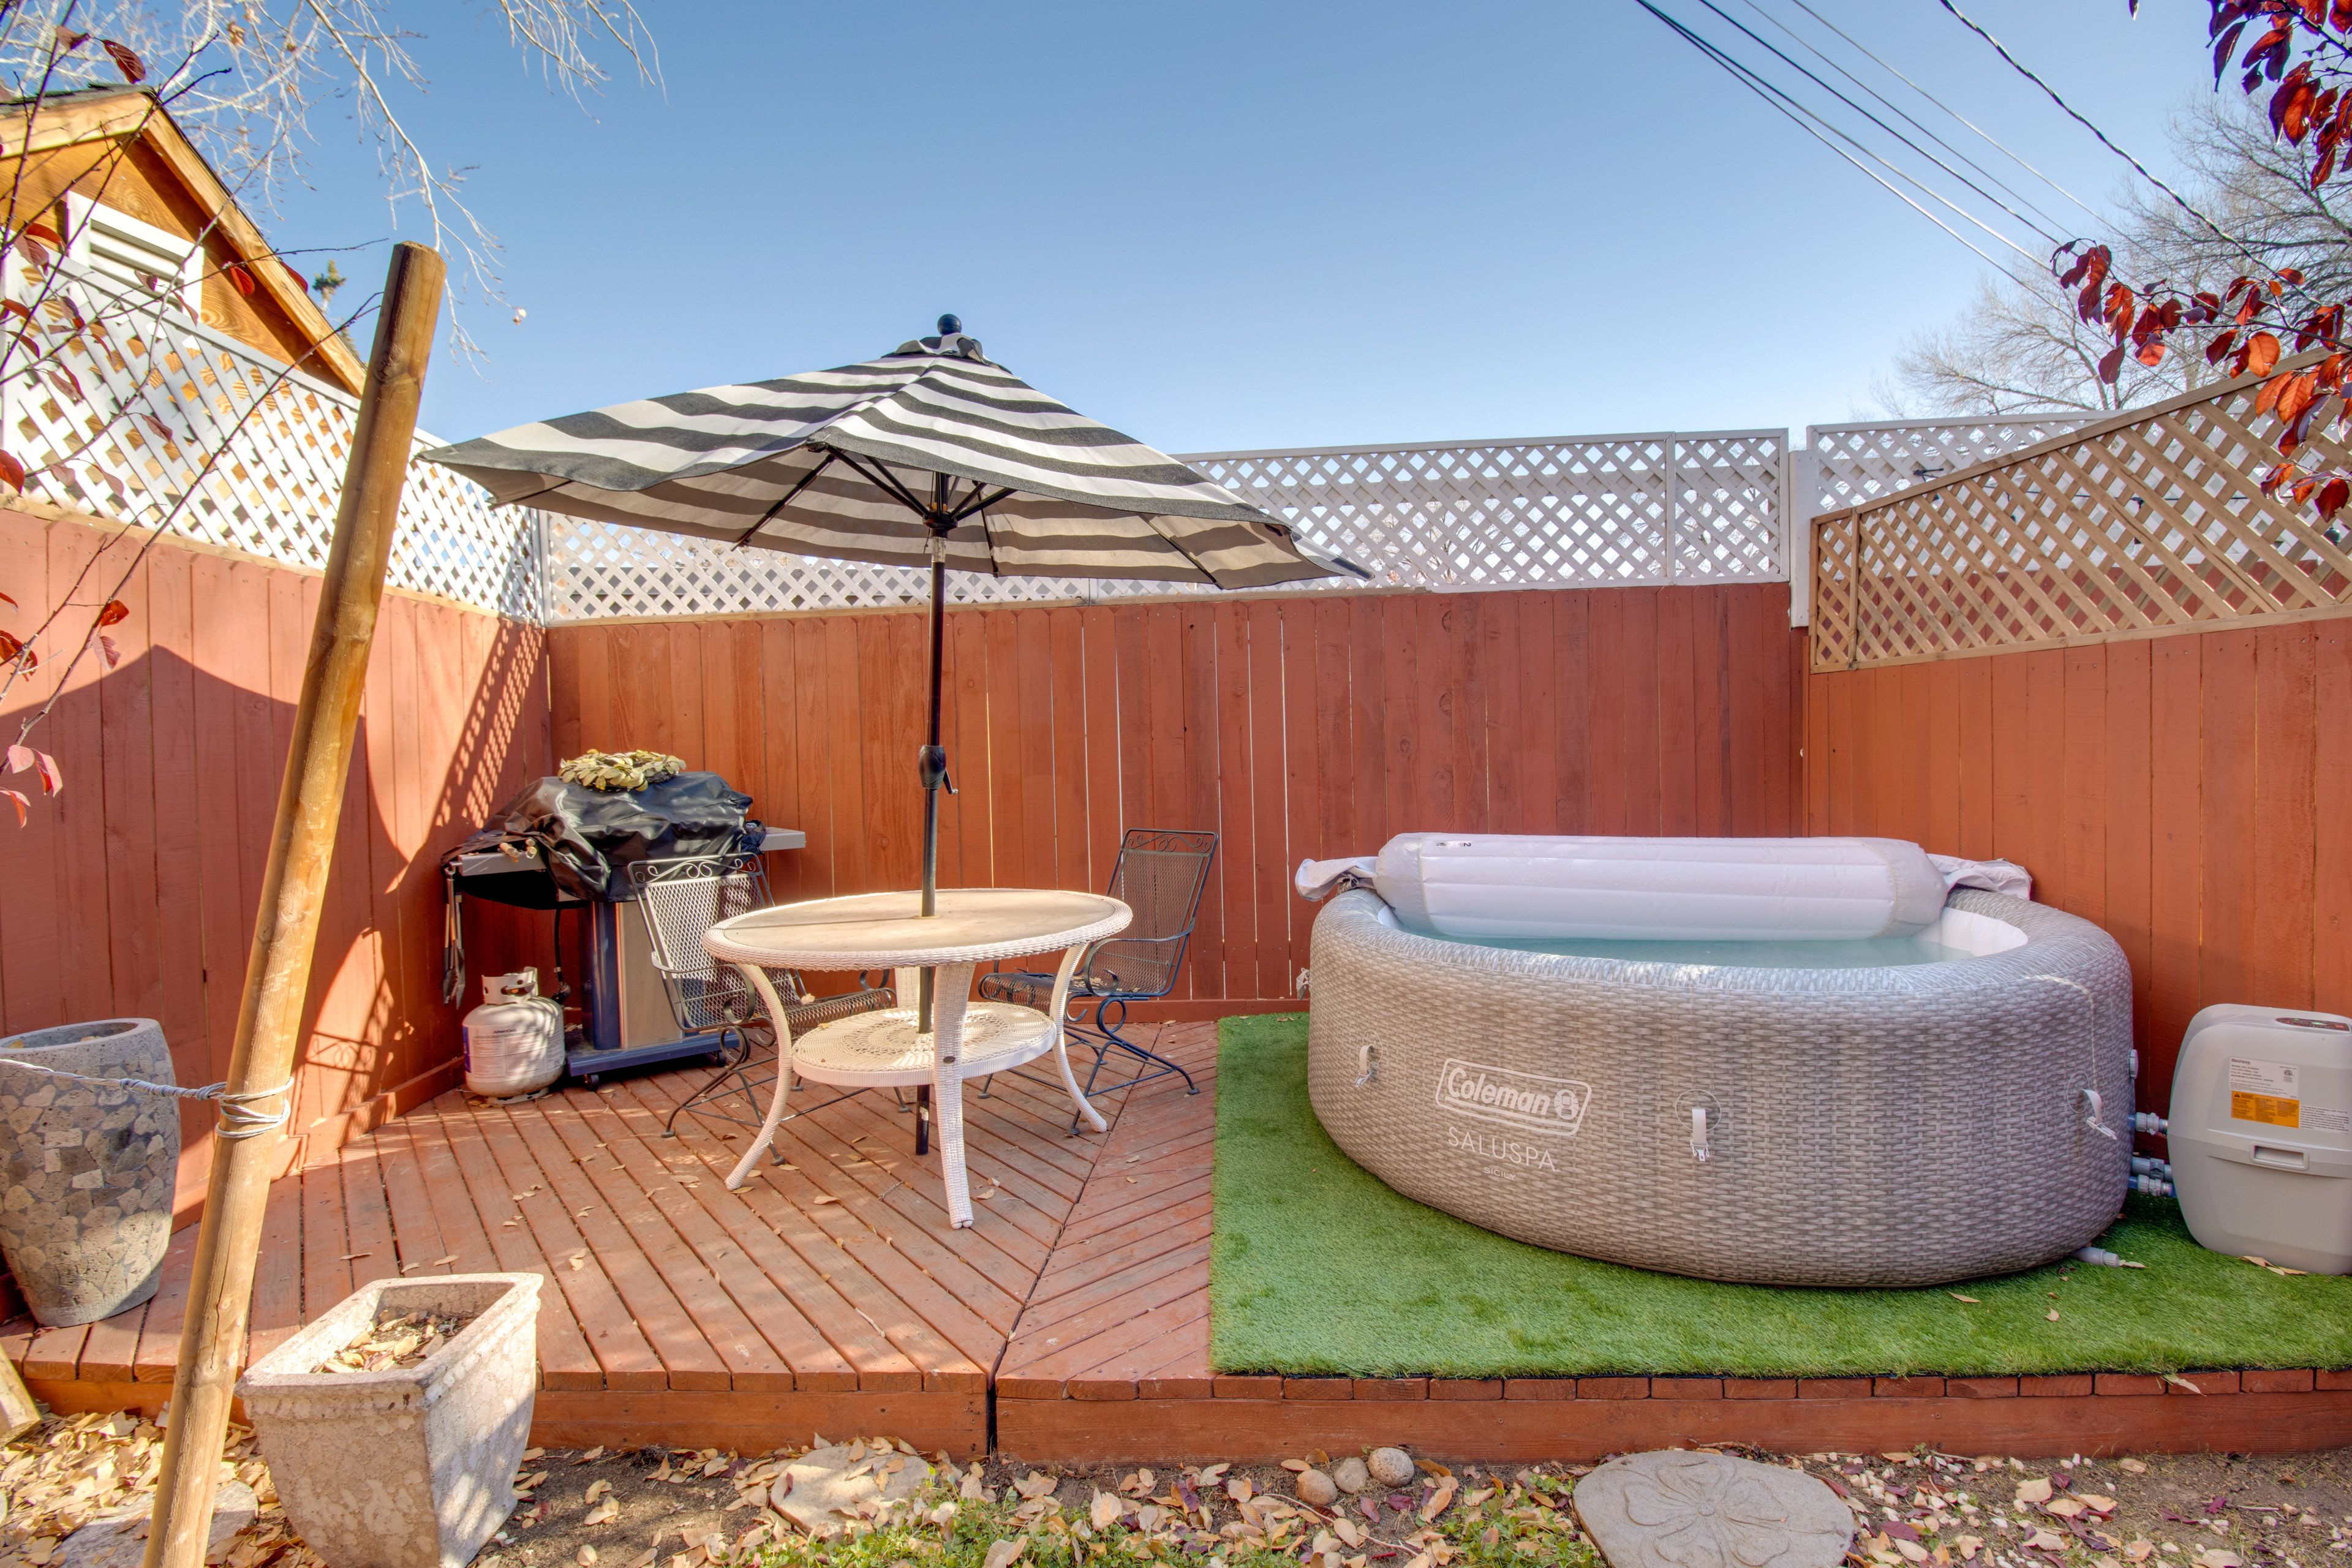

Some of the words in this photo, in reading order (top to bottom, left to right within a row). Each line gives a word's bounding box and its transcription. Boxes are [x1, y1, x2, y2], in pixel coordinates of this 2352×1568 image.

[1447, 1067, 1551, 1116] Coleman
[1448, 1126, 1556, 1172] SALUSPA
[1483, 1166, 1517, 1181] SICILY
